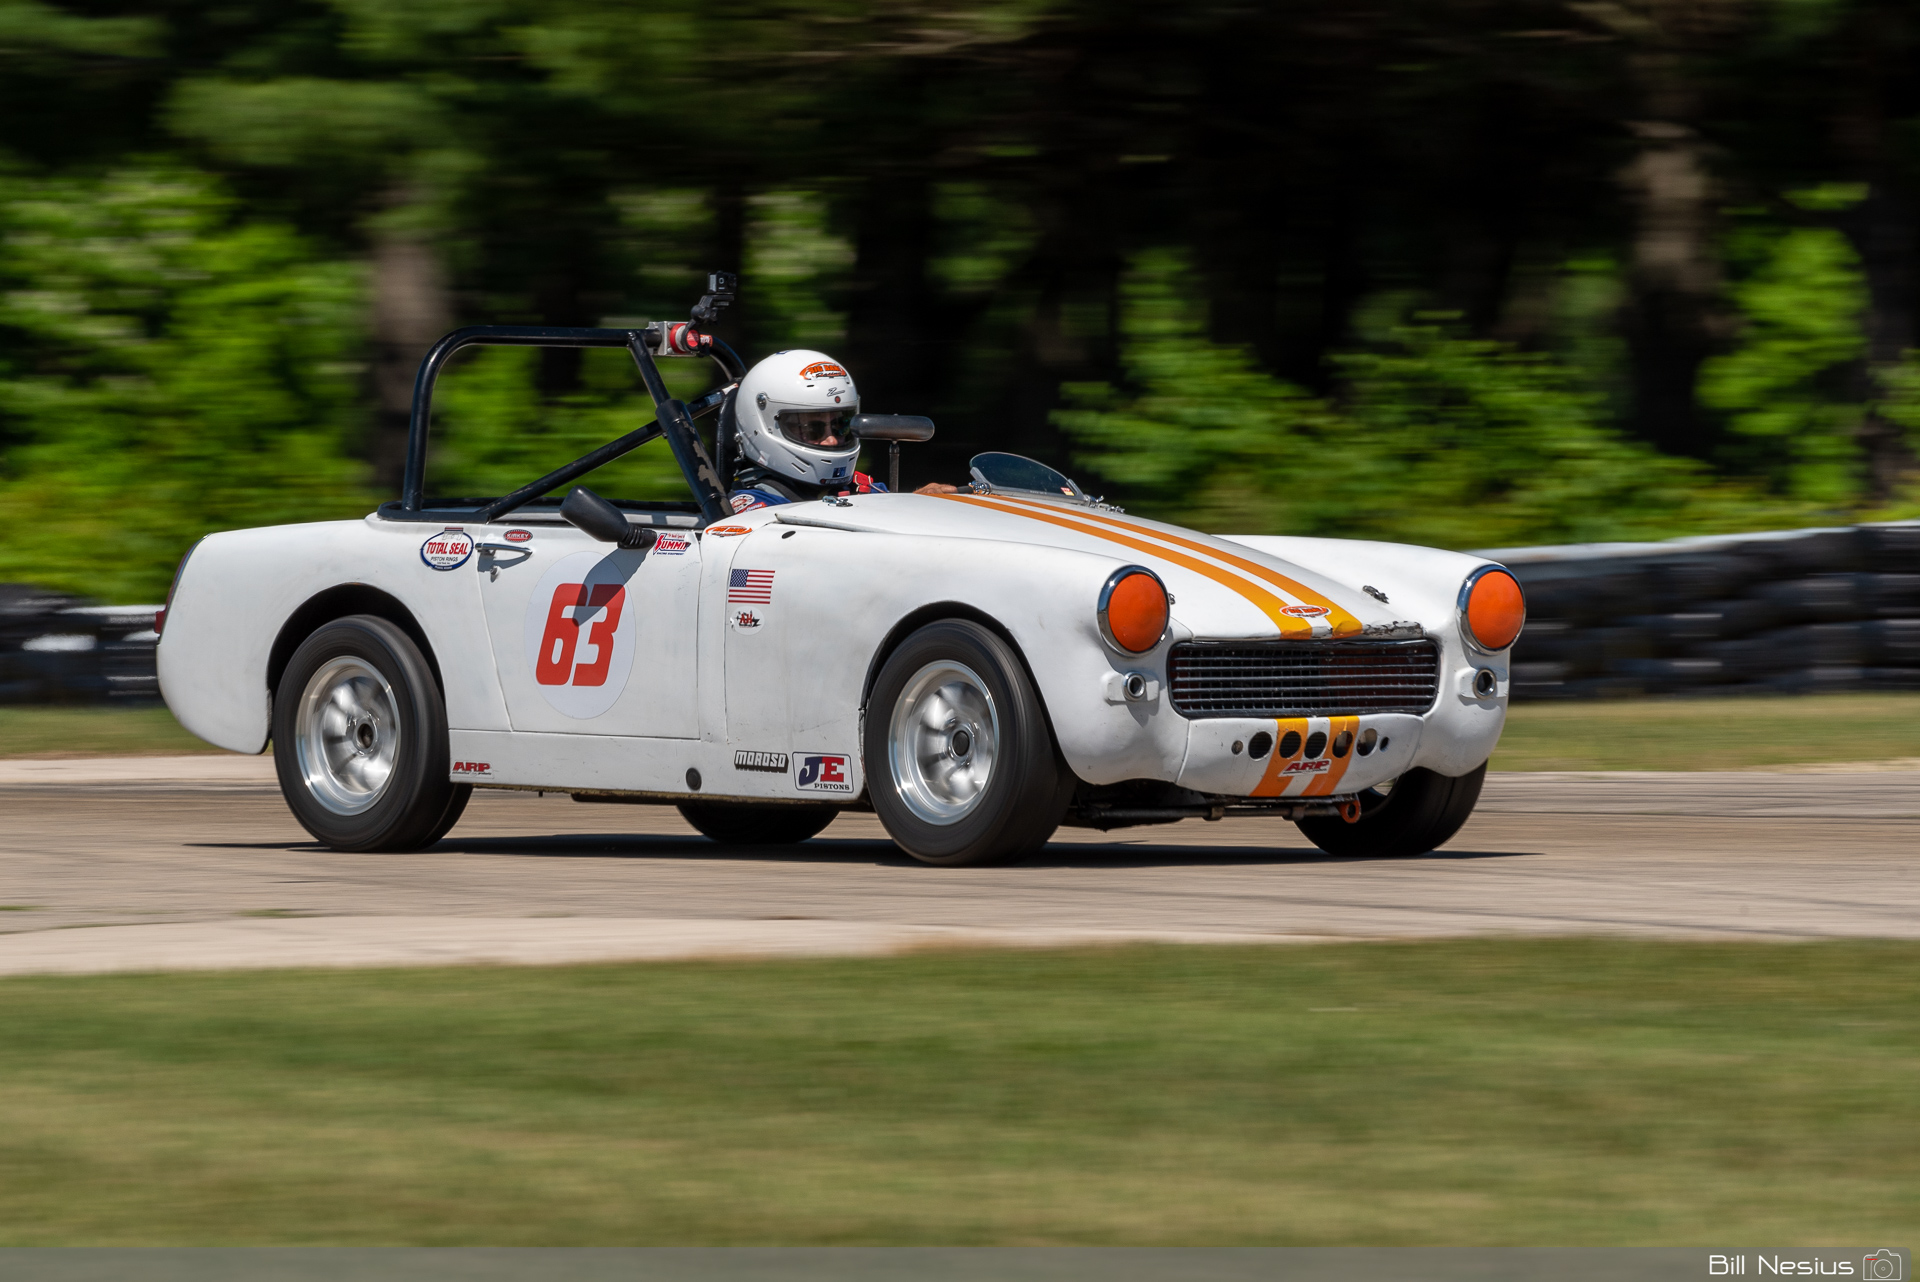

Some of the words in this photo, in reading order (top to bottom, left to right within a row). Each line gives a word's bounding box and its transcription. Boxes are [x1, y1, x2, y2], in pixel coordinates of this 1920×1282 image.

[426, 541, 448, 554] TOTAL
[449, 542, 468, 555] SEAL
[535, 583, 626, 686] 63
[453, 761, 490, 772] ARP
[734, 750, 788, 771] MOROSO
[1285, 760, 1330, 771] ARP
[799, 756, 845, 786] JE
[814, 782, 850, 791] PISTONS
